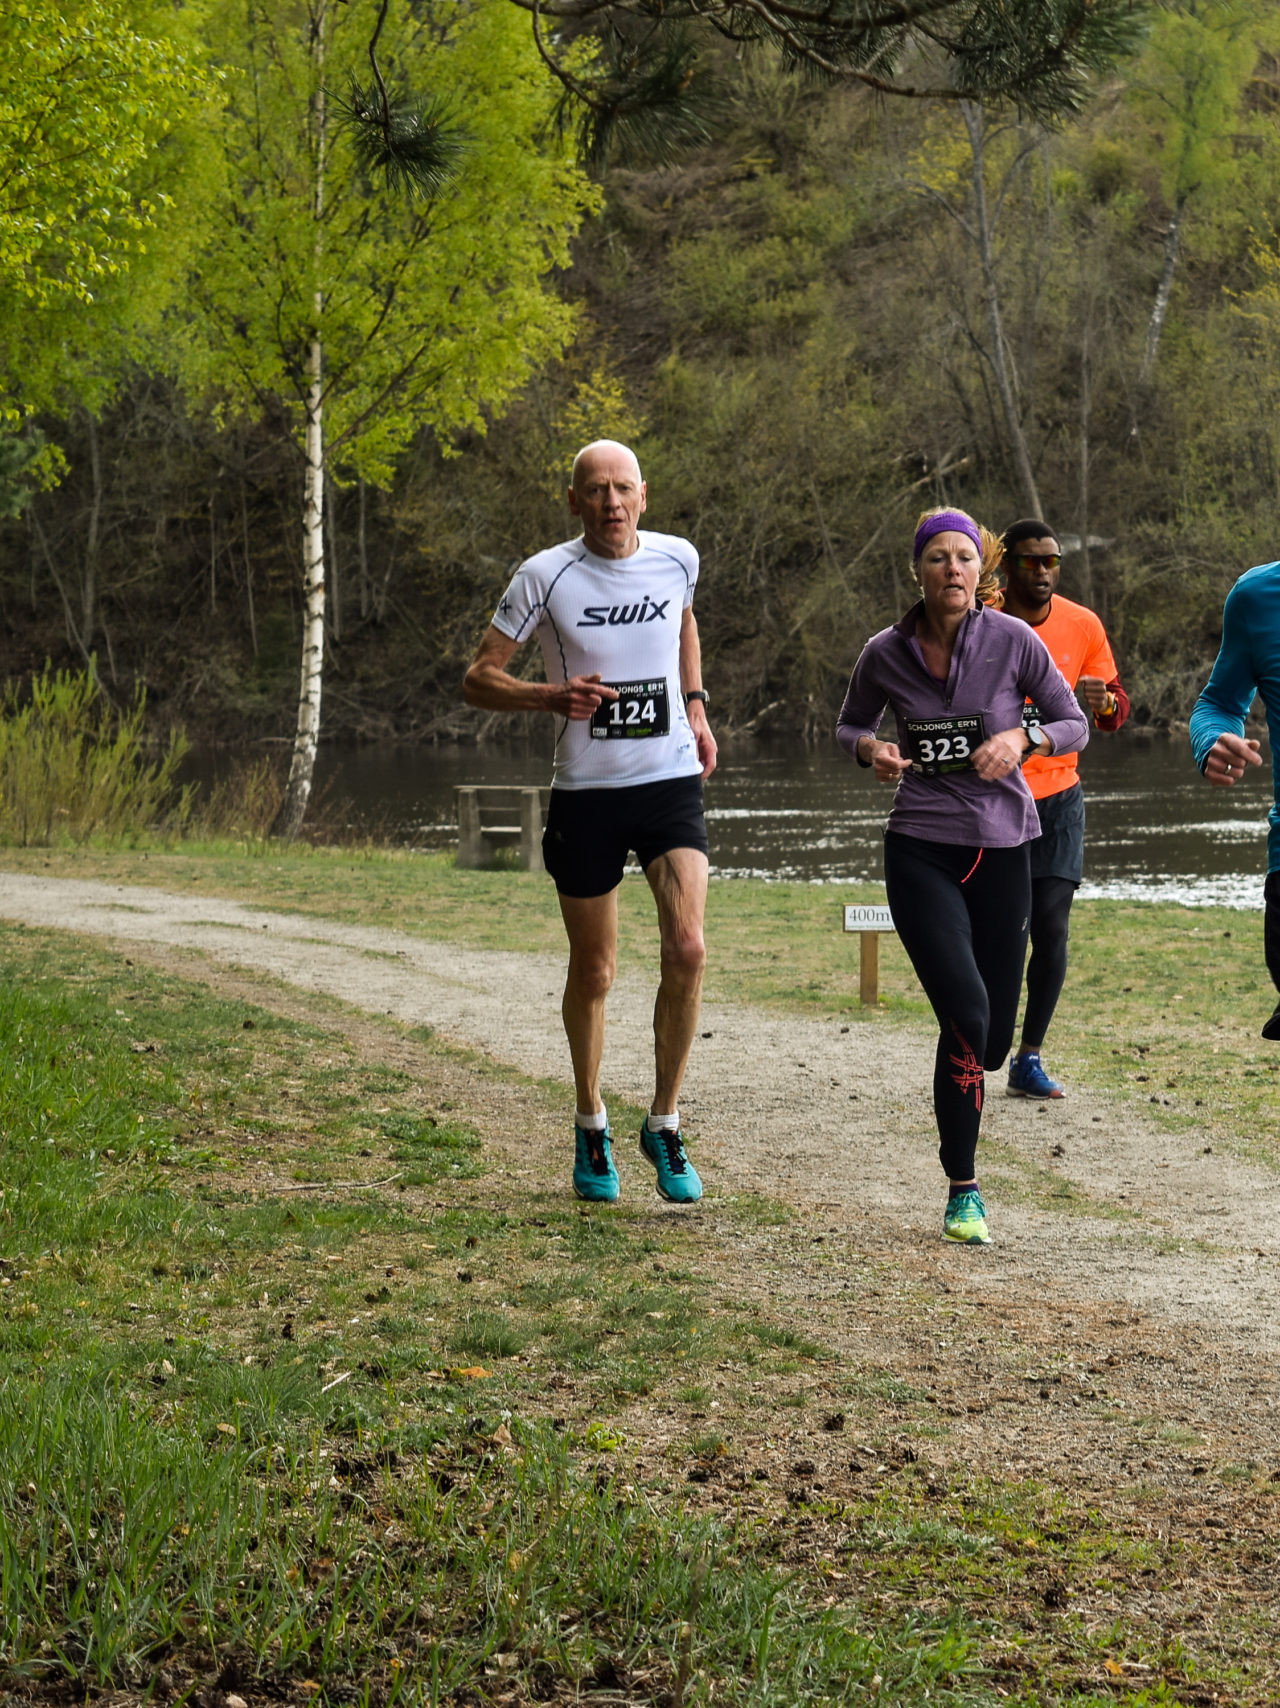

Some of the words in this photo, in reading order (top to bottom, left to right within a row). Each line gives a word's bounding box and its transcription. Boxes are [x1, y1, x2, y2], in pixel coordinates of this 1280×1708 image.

[609, 699, 657, 725] 124
[918, 736, 971, 762] 323
[849, 908, 890, 921] 400m
